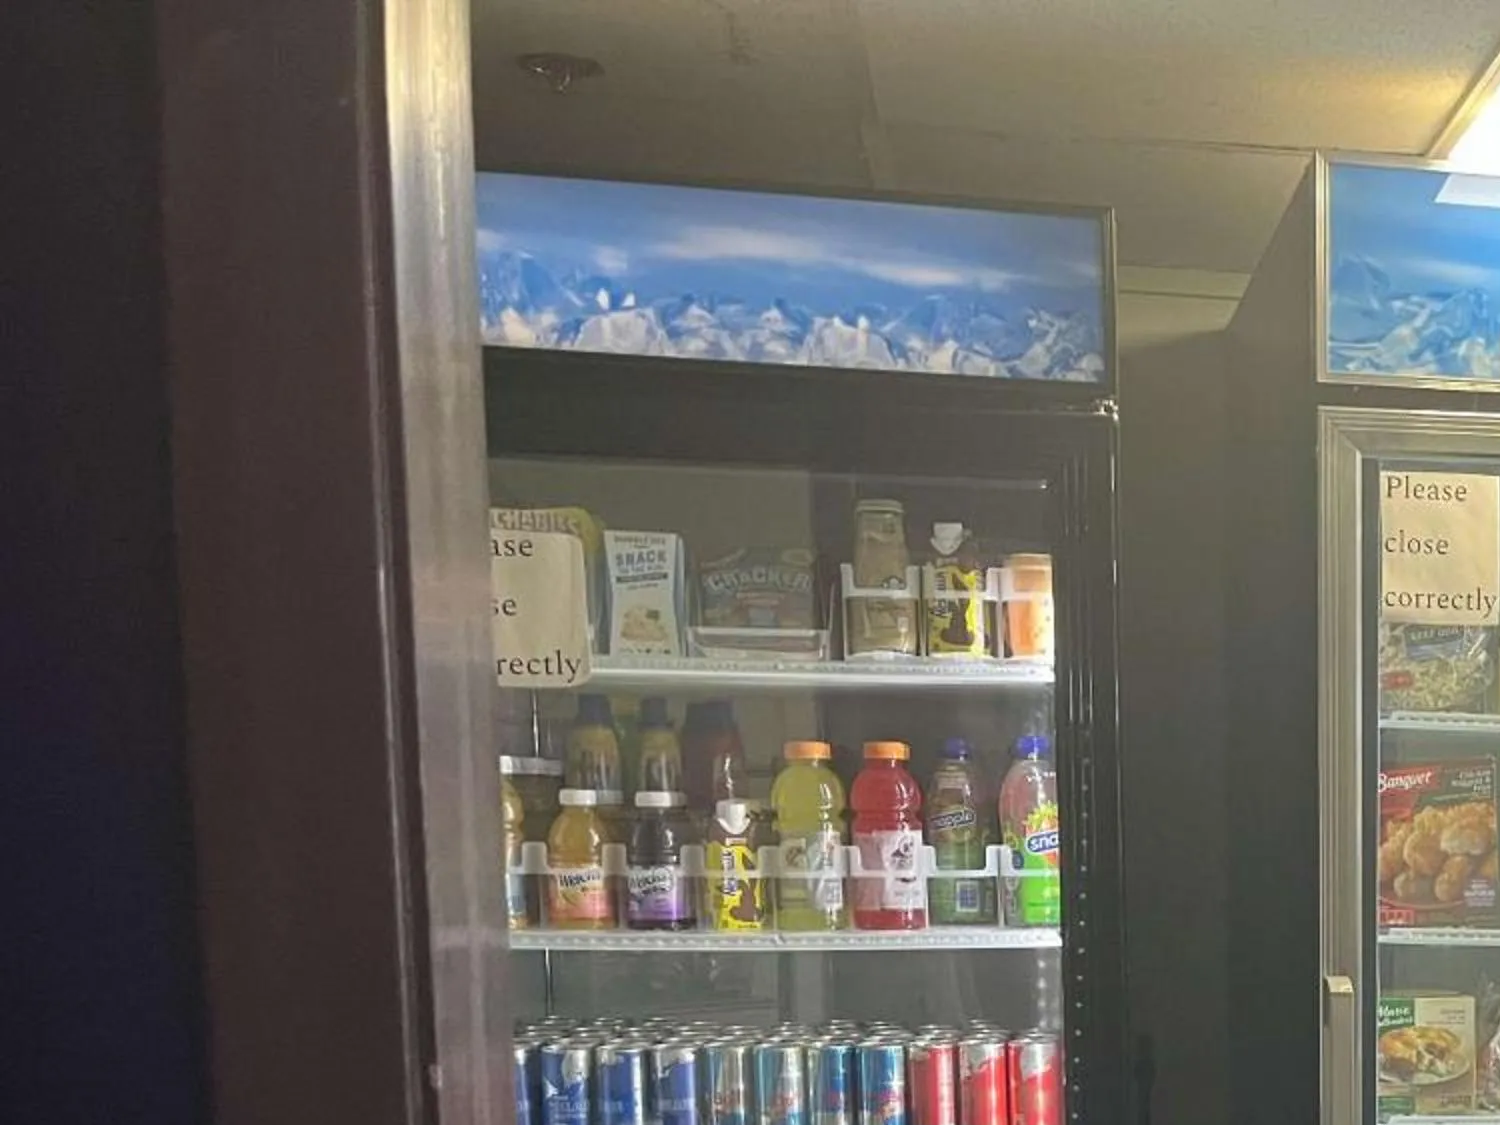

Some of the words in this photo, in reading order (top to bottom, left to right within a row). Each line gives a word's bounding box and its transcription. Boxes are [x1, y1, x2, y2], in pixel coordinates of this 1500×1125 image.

[1386, 475, 1467, 502] Please
[1385, 529, 1449, 555] close
[615, 550, 668, 567] SNACK
[1384, 587, 1498, 618] correctly
